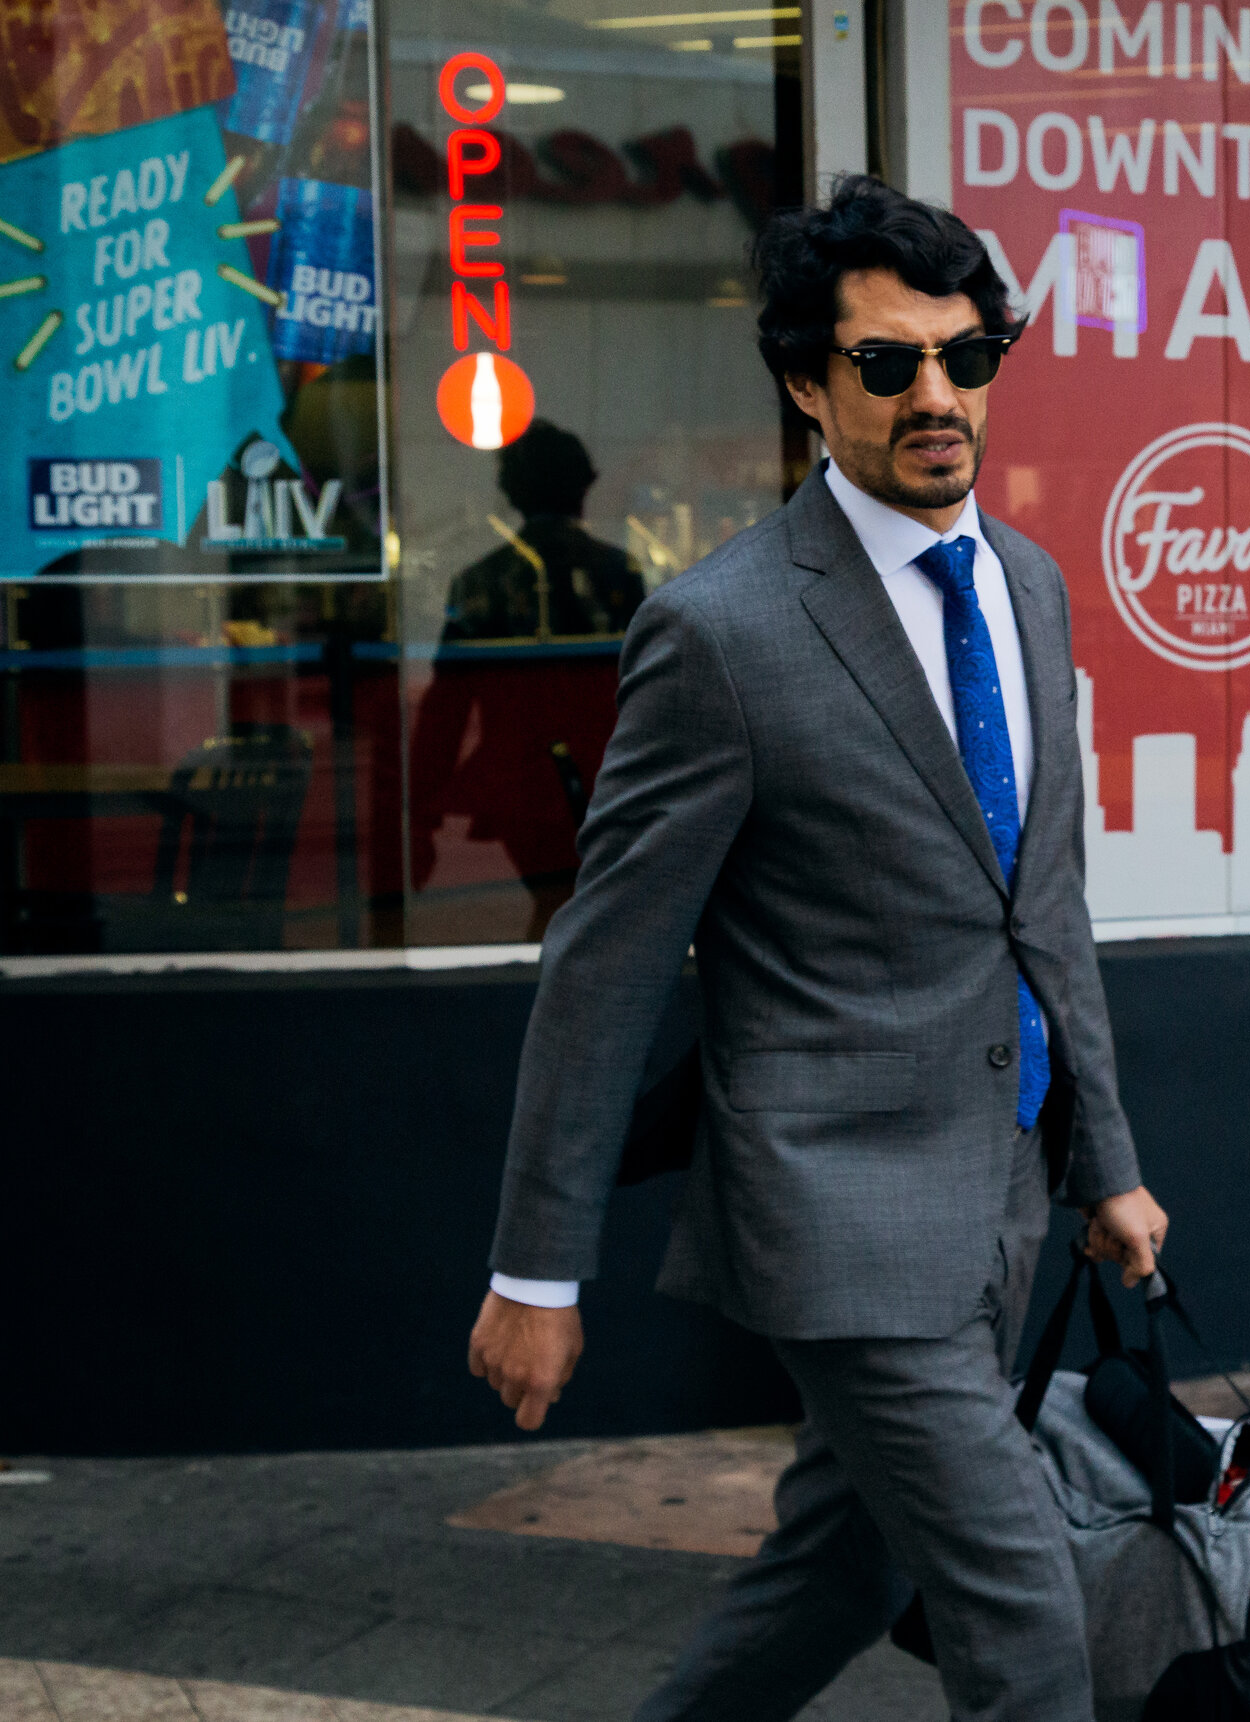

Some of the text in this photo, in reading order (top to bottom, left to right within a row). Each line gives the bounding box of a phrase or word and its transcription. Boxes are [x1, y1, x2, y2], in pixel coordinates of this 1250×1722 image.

[60, 151, 190, 233] READY
[438, 52, 511, 351] OPEN
[94, 219, 170, 285] FOR
[291, 264, 371, 302] BUD
[76, 269, 202, 355] SUPER
[277, 290, 379, 334] LIGHT
[49, 319, 257, 422] BOWL LIV.
[50, 463, 140, 494] BUD
[34, 494, 156, 527] LIGHT
[1176, 583, 1248, 614] PIZZA
